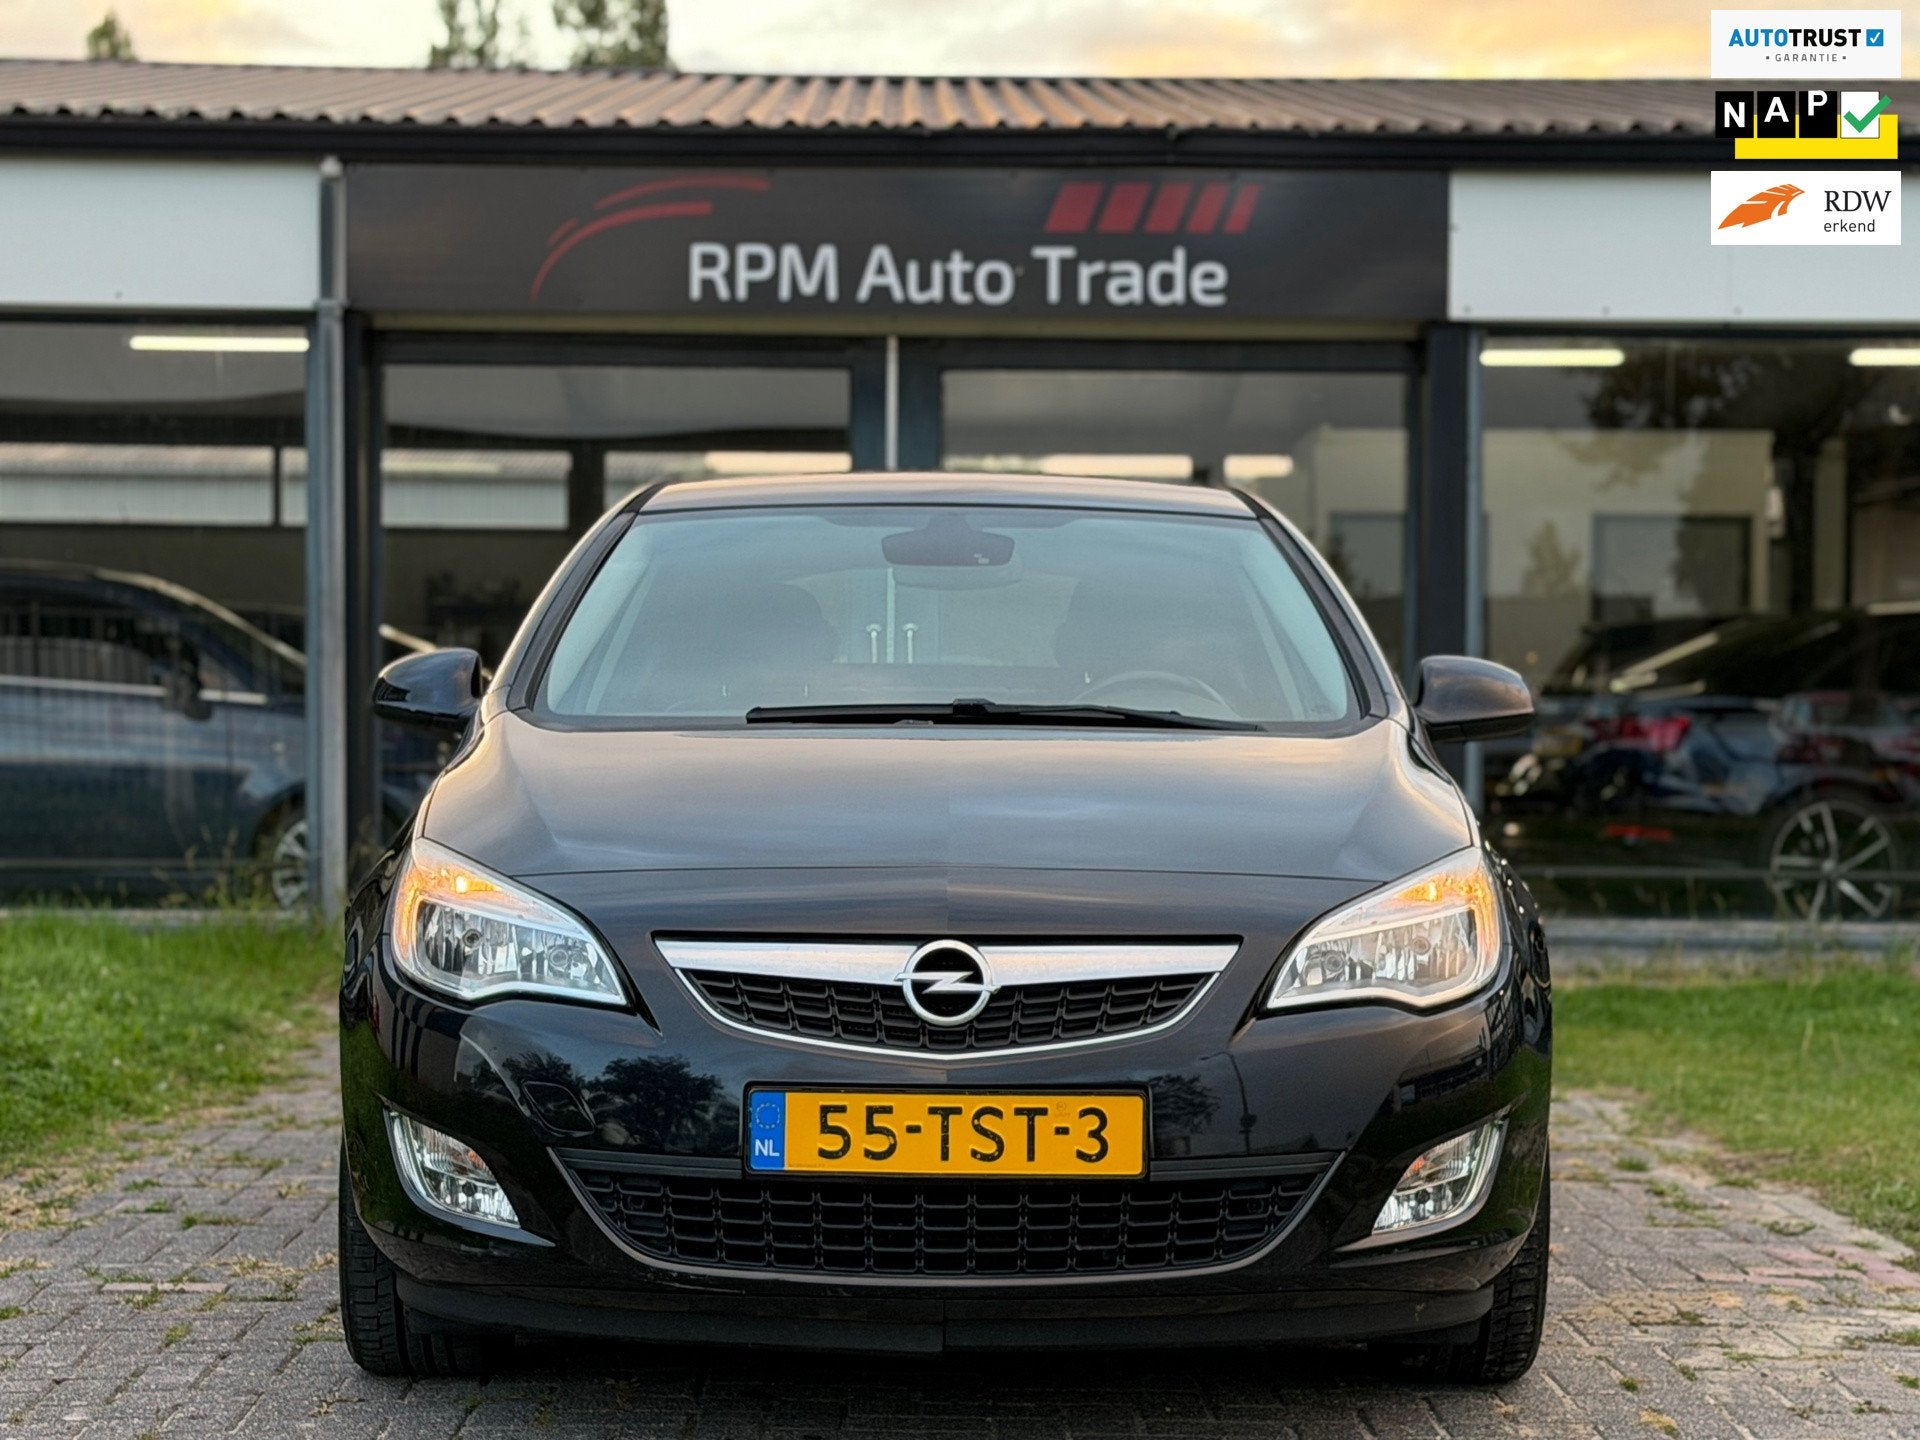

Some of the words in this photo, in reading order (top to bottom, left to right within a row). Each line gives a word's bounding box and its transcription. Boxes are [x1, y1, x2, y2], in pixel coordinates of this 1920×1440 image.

[688, 242, 839, 302] RPM
[855, 244, 1015, 305] Auto
[1030, 246, 1229, 307] Trade
[754, 1138, 780, 1157] NL
[817, 1104, 1110, 1163] 55-TST-3
